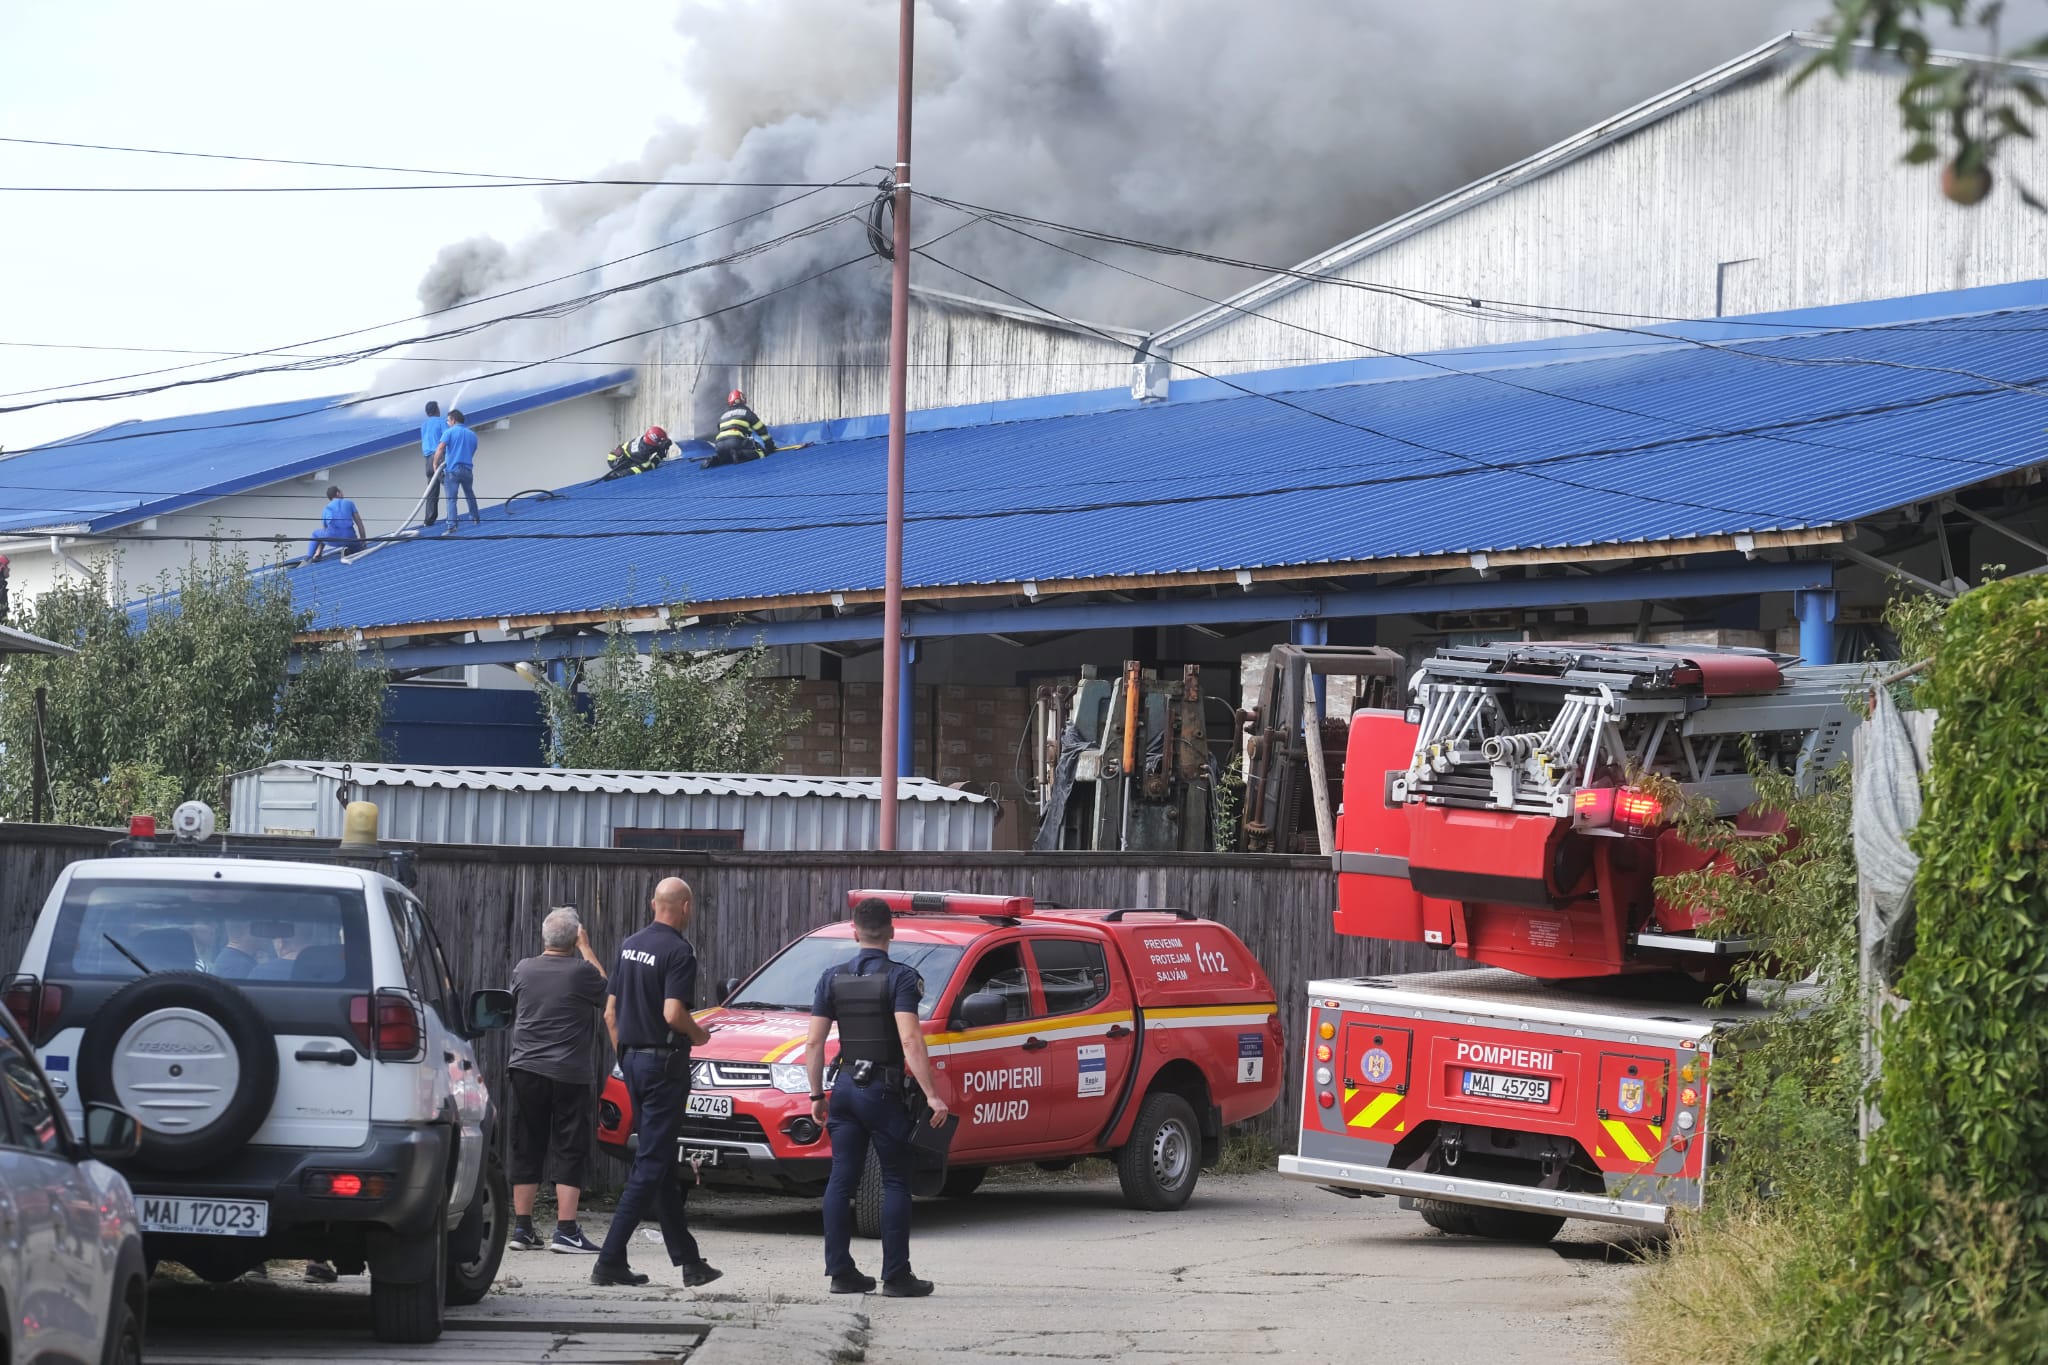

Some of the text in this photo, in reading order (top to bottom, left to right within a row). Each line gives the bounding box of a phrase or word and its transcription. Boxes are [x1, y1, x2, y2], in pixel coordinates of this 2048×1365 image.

[1143, 938, 1183, 950] PREVENIM
[1149, 953, 1192, 965] PROTEJAM
[1202, 951, 1229, 973] 112
[1457, 1042, 1553, 1071] POMPIERII
[963, 1066, 1042, 1094] POMPIERII
[1471, 1074, 1494, 1092] MAI
[1502, 1078, 1545, 1098] 45795
[690, 1097, 728, 1114] 42748
[972, 1099, 1029, 1125] SMURD
[143, 1199, 257, 1229] MAI 17023
